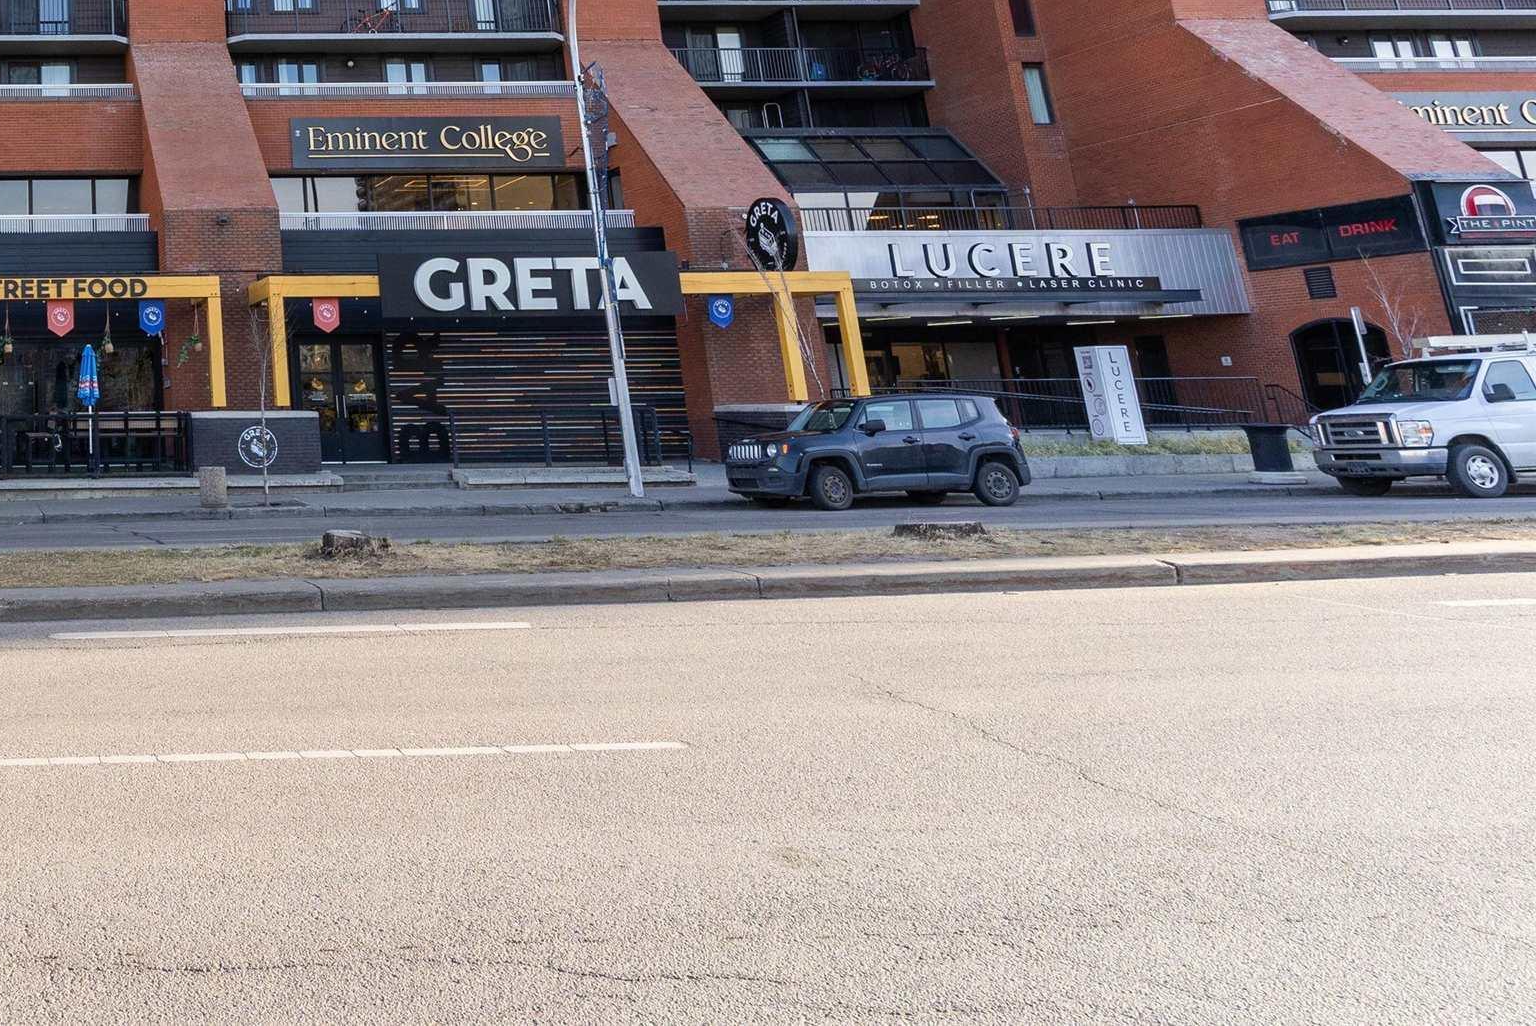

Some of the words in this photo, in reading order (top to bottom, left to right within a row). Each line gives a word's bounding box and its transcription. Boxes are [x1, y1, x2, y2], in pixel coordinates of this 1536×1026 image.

[1399, 100, 1513, 125] minent
[308, 126, 429, 150] Eminent
[439, 124, 548, 162] College
[749, 202, 778, 227] GRETA
[1460, 220, 1490, 228] THE
[1501, 219, 1536, 228] PINT
[1270, 232, 1300, 246] EAT
[1338, 219, 1397, 237] DRINK
[888, 242, 1115, 277] LUCERE
[73, 278, 148, 299] FOOD
[413, 257, 652, 312] GRETA
[870, 280, 923, 289] BOTOX
[947, 280, 1006, 289] FILLER
[1029, 279, 1081, 288] LASER
[1088, 278, 1145, 288] CLINIC
[1108, 351, 1132, 432] LUCERE
